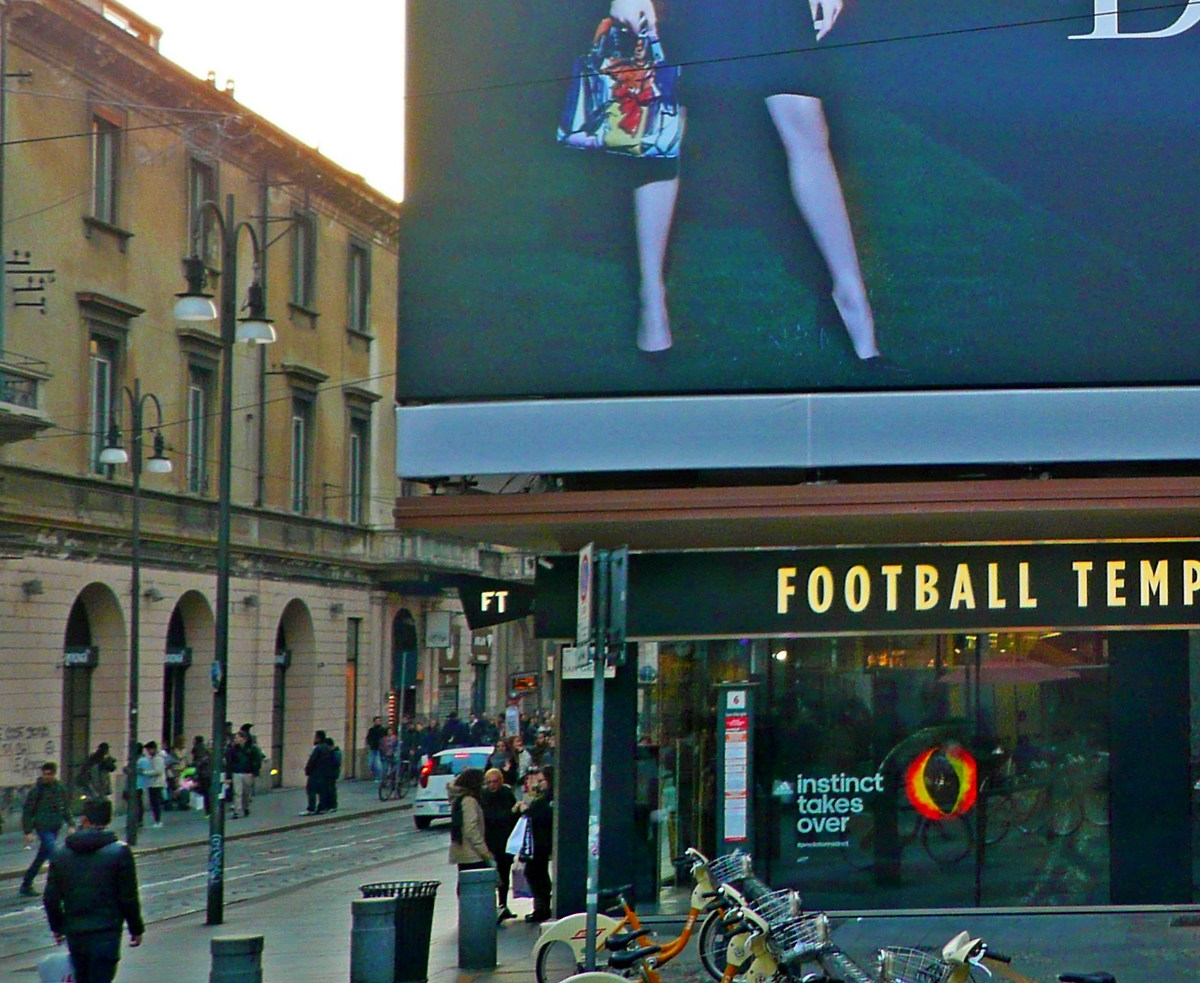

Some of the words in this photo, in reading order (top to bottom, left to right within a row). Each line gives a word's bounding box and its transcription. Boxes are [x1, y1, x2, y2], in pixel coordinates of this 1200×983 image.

[776, 561, 1038, 615] FOOTBALL
[480, 590, 510, 614] FT
[733, 695, 740, 705] 6
[796, 772, 885, 794] instinct
[796, 794, 864, 814] takes
[796, 816, 850, 834] over
